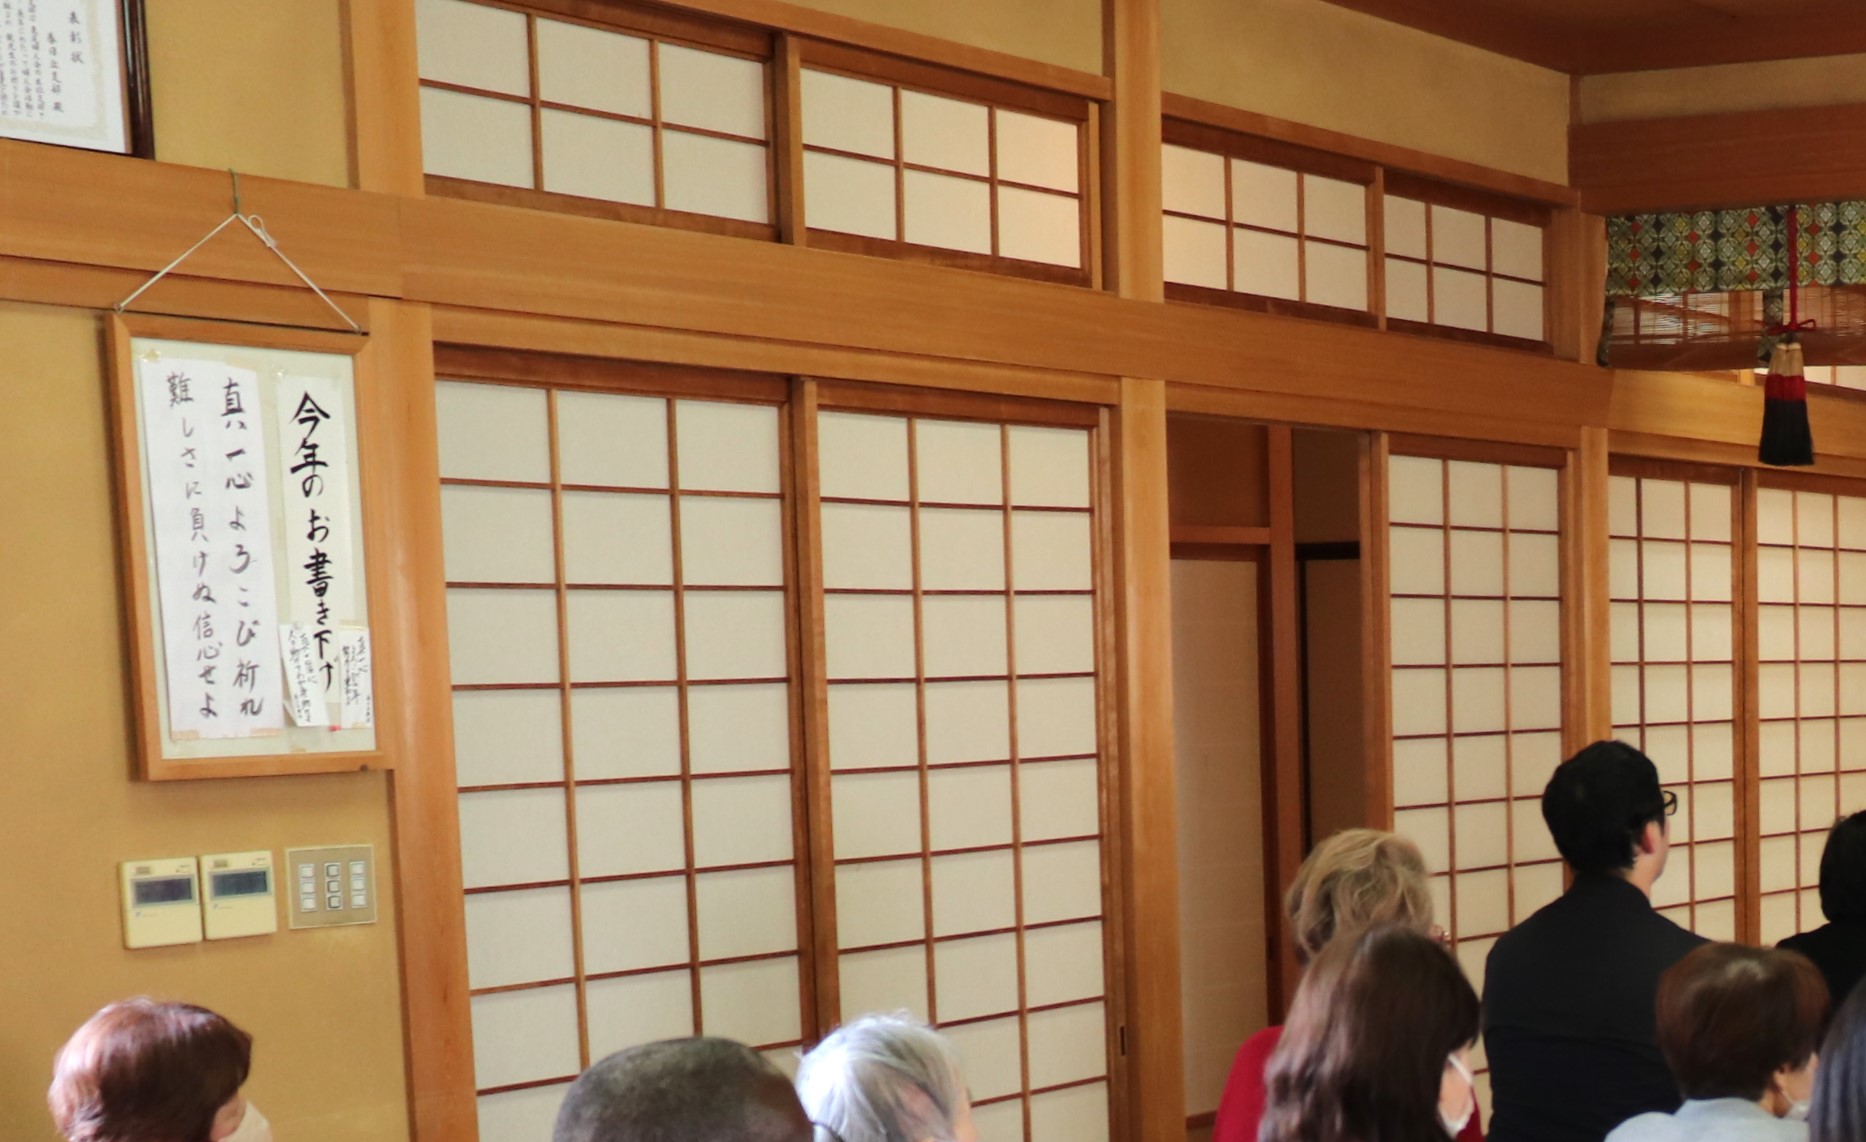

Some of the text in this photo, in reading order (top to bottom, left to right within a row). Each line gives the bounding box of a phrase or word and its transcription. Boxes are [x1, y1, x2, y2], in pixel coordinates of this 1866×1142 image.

[69, 11, 84, 64] 表彰状
[166, 372, 223, 719] 難しさに負けぬ信心せよ
[220, 377, 264, 717] 真一心よろこび祈れ
